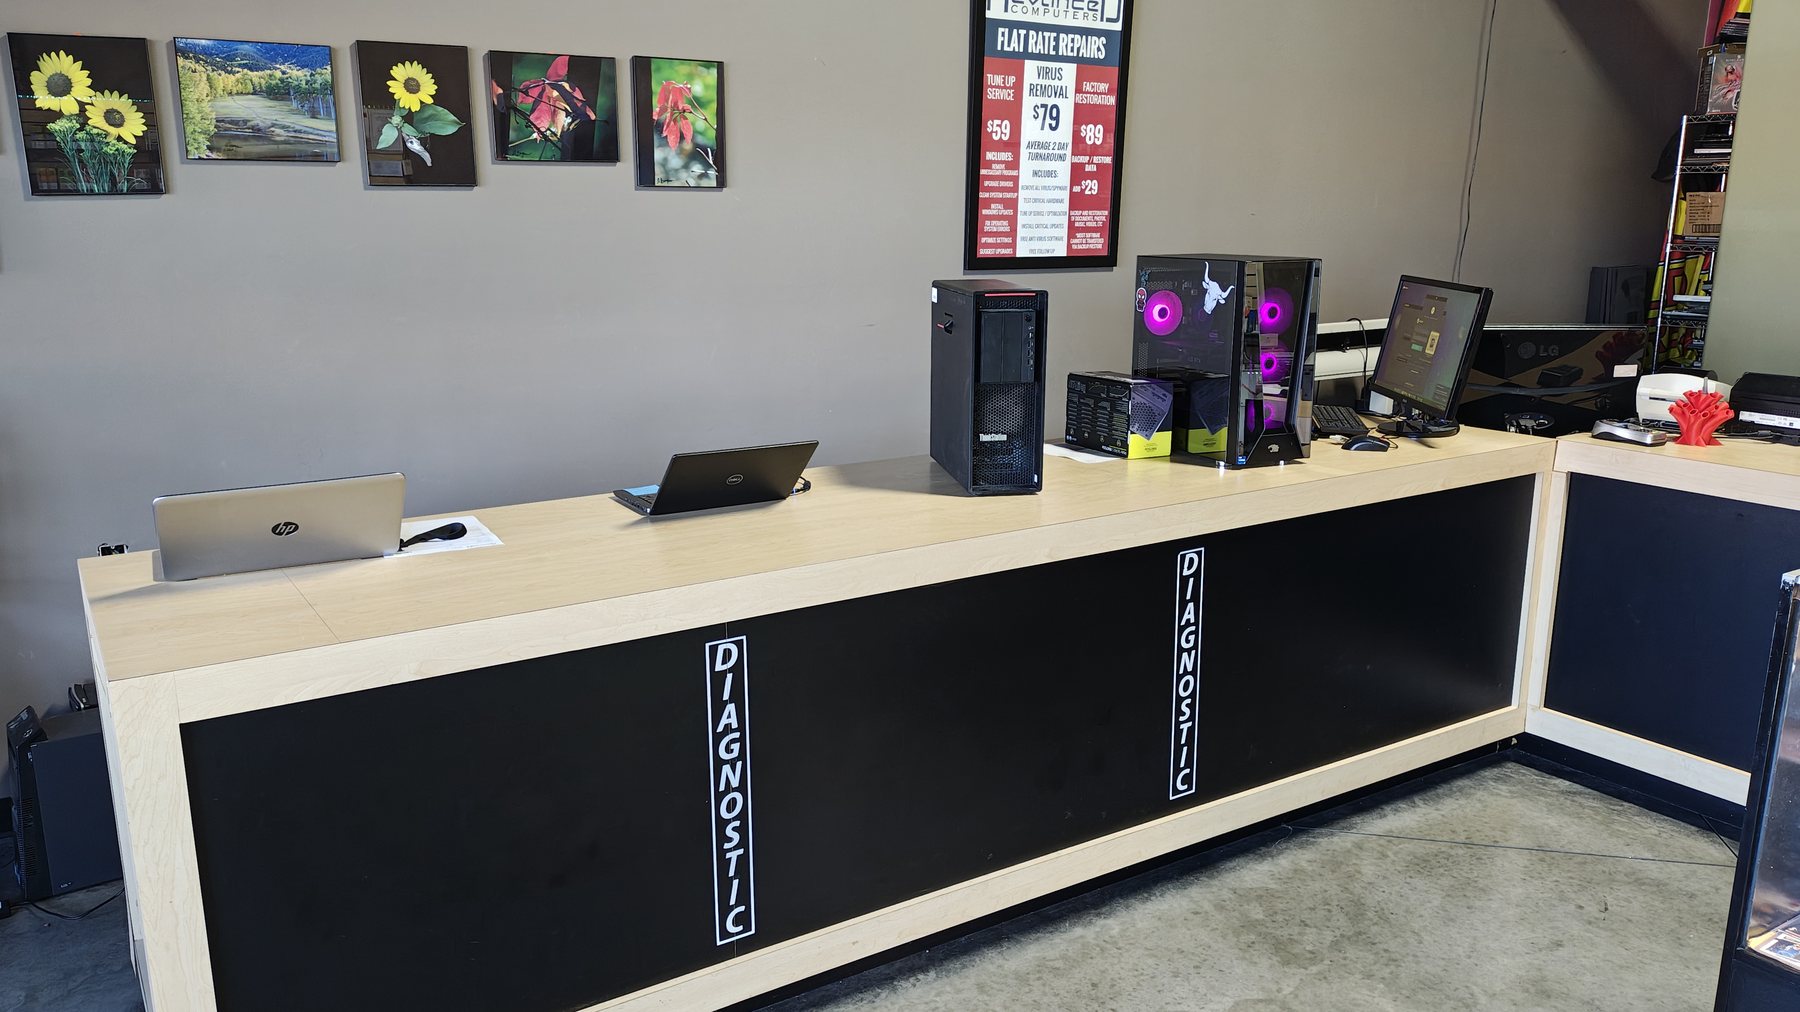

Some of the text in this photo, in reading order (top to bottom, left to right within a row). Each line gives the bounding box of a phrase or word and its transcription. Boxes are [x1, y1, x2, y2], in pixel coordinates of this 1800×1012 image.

[1010, 4, 1098, 21] COMPUTERS
[997, 27, 1107, 59] FLAT RATE REPAIRS
[987, 74, 1016, 87] TUNE UP
[1036, 65, 1063, 81] VIRUS
[987, 88, 1015, 101] SERVICE
[1028, 83, 1069, 99] REMOVAL
[1083, 82, 1109, 93] FACTORY
[1075, 94, 1115, 106] RESTORATION
[1032, 103, 1061, 131] $79
[987, 119, 1011, 141] $59
[1080, 124, 1104, 145] $89
[1026, 141, 1069, 151] AVERAGE 2 DAY
[986, 151, 1013, 161] INCLUDES:
[1028, 152, 1067, 162] TURNAROUND
[1032, 169, 1059, 178] INCLUDES:
[1081, 179, 1098, 195] $29
[1539, 345, 1559, 356] LG
[1176, 552, 1200, 791] DIAGNOSTIC
[714, 644, 745, 933] DIAGNOSTIC
